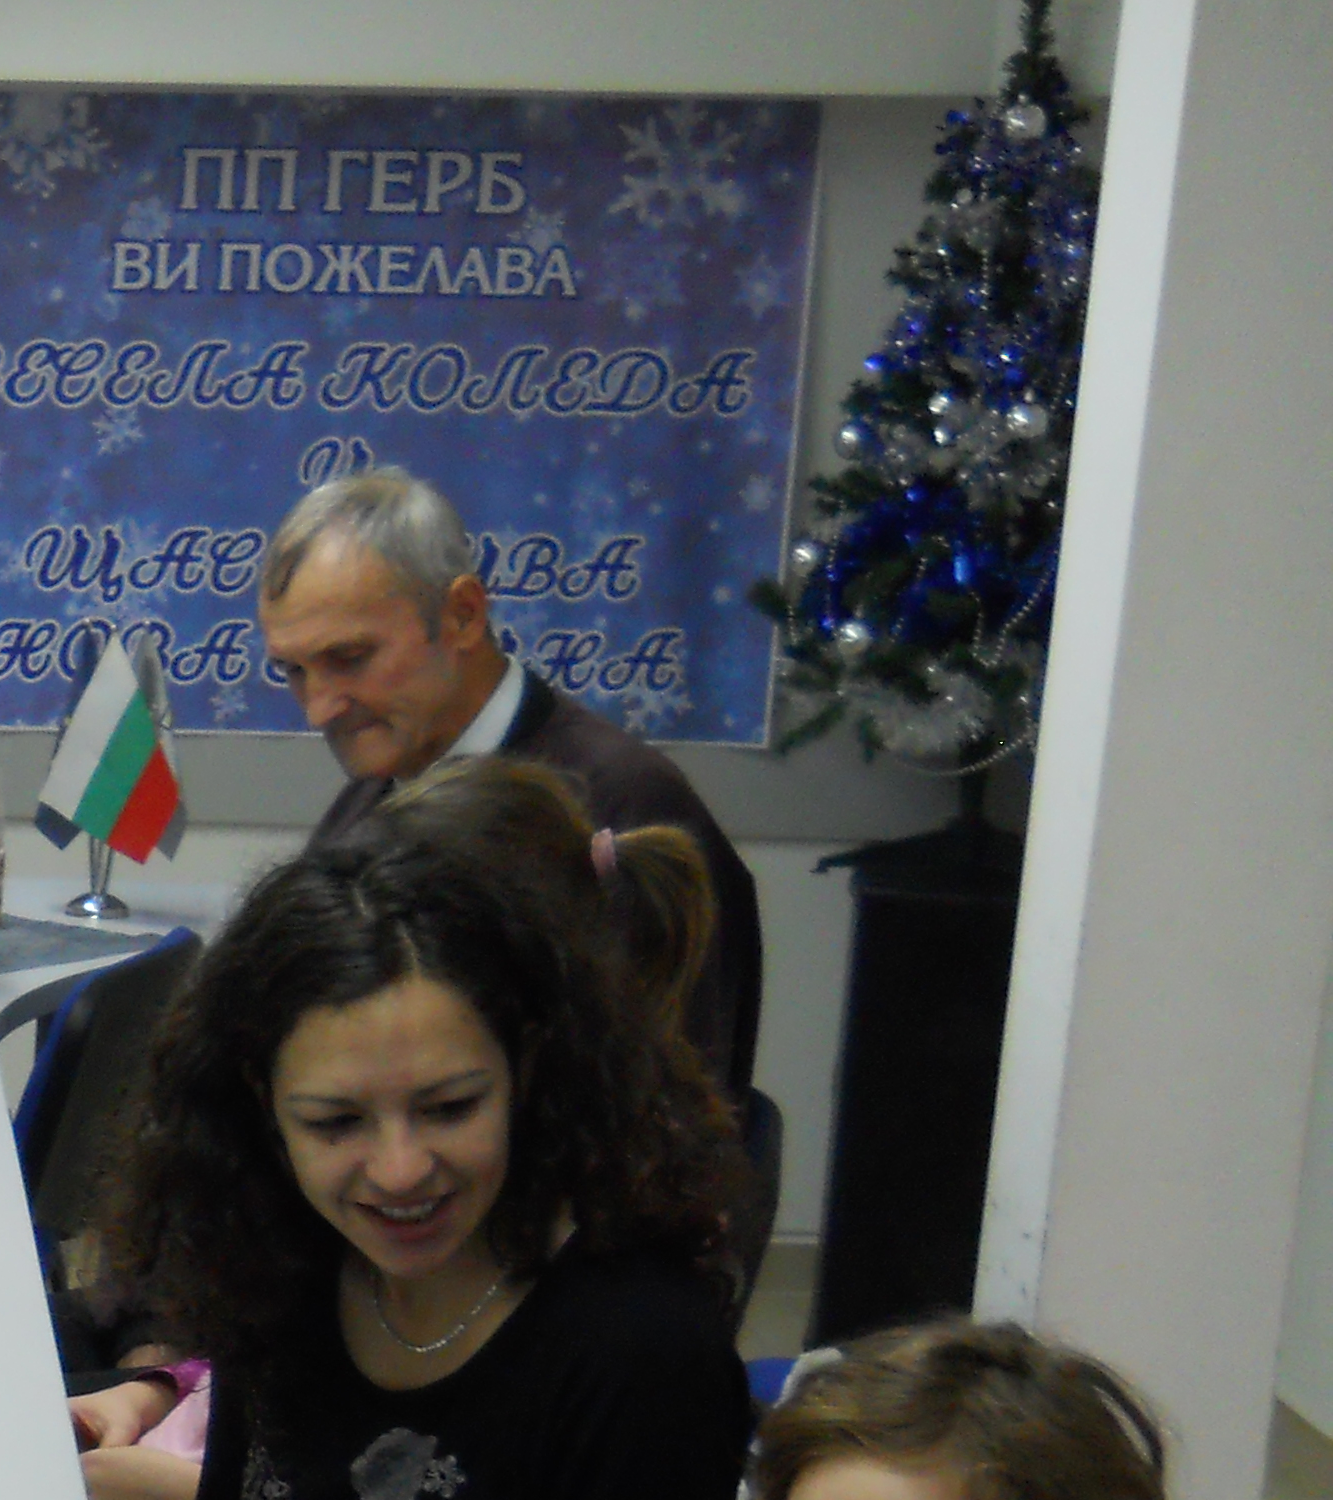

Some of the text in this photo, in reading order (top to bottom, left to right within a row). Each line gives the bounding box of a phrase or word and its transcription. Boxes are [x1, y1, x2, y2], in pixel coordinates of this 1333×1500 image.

[180, 147, 527, 216] ПП ГЕРБ
[110, 241, 578, 298] ВИ ПОЖЕЛАВА
[320, 342, 755, 419] КОЛЕДА
